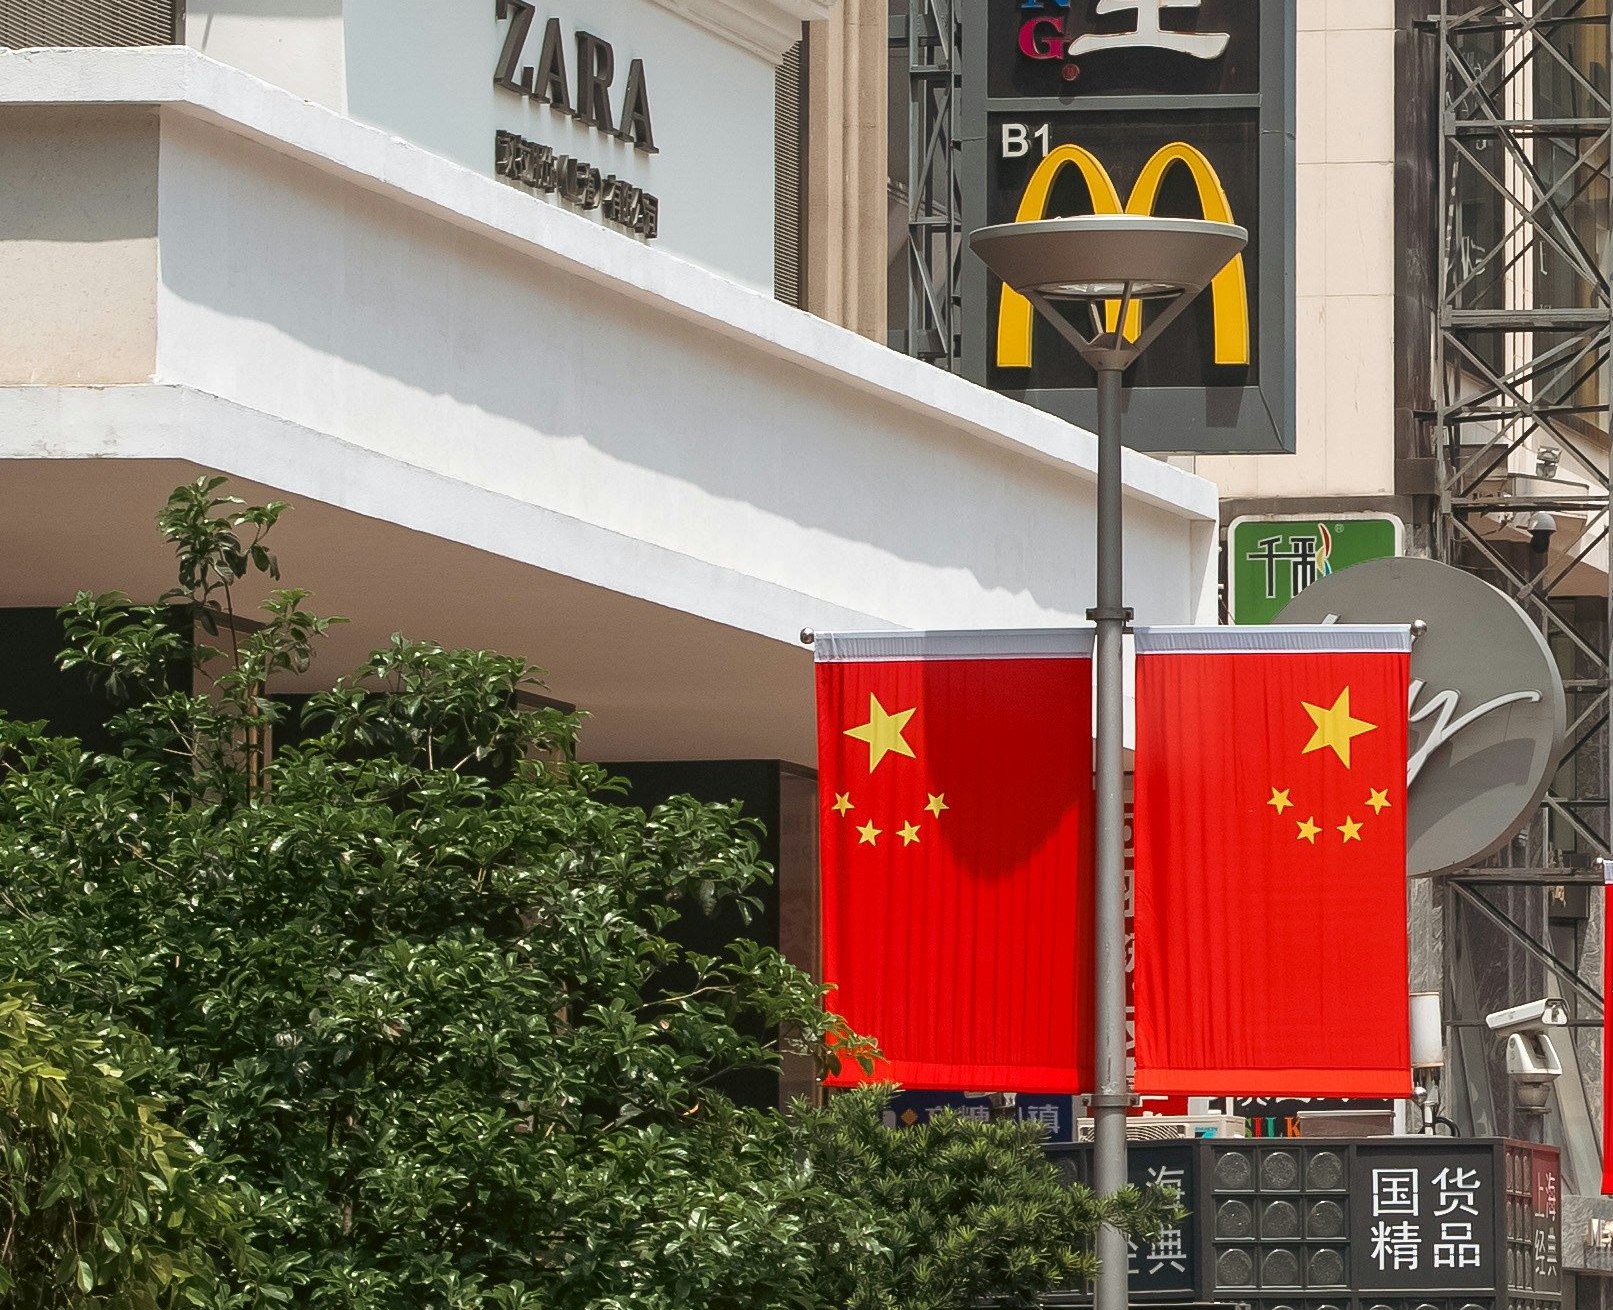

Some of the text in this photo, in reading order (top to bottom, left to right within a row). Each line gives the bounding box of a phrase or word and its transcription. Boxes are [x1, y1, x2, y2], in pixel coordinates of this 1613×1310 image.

[1001, 122, 1053, 159] B1
[1371, 1165, 1482, 1218] 国货
[1370, 1219, 1482, 1272] 精品
